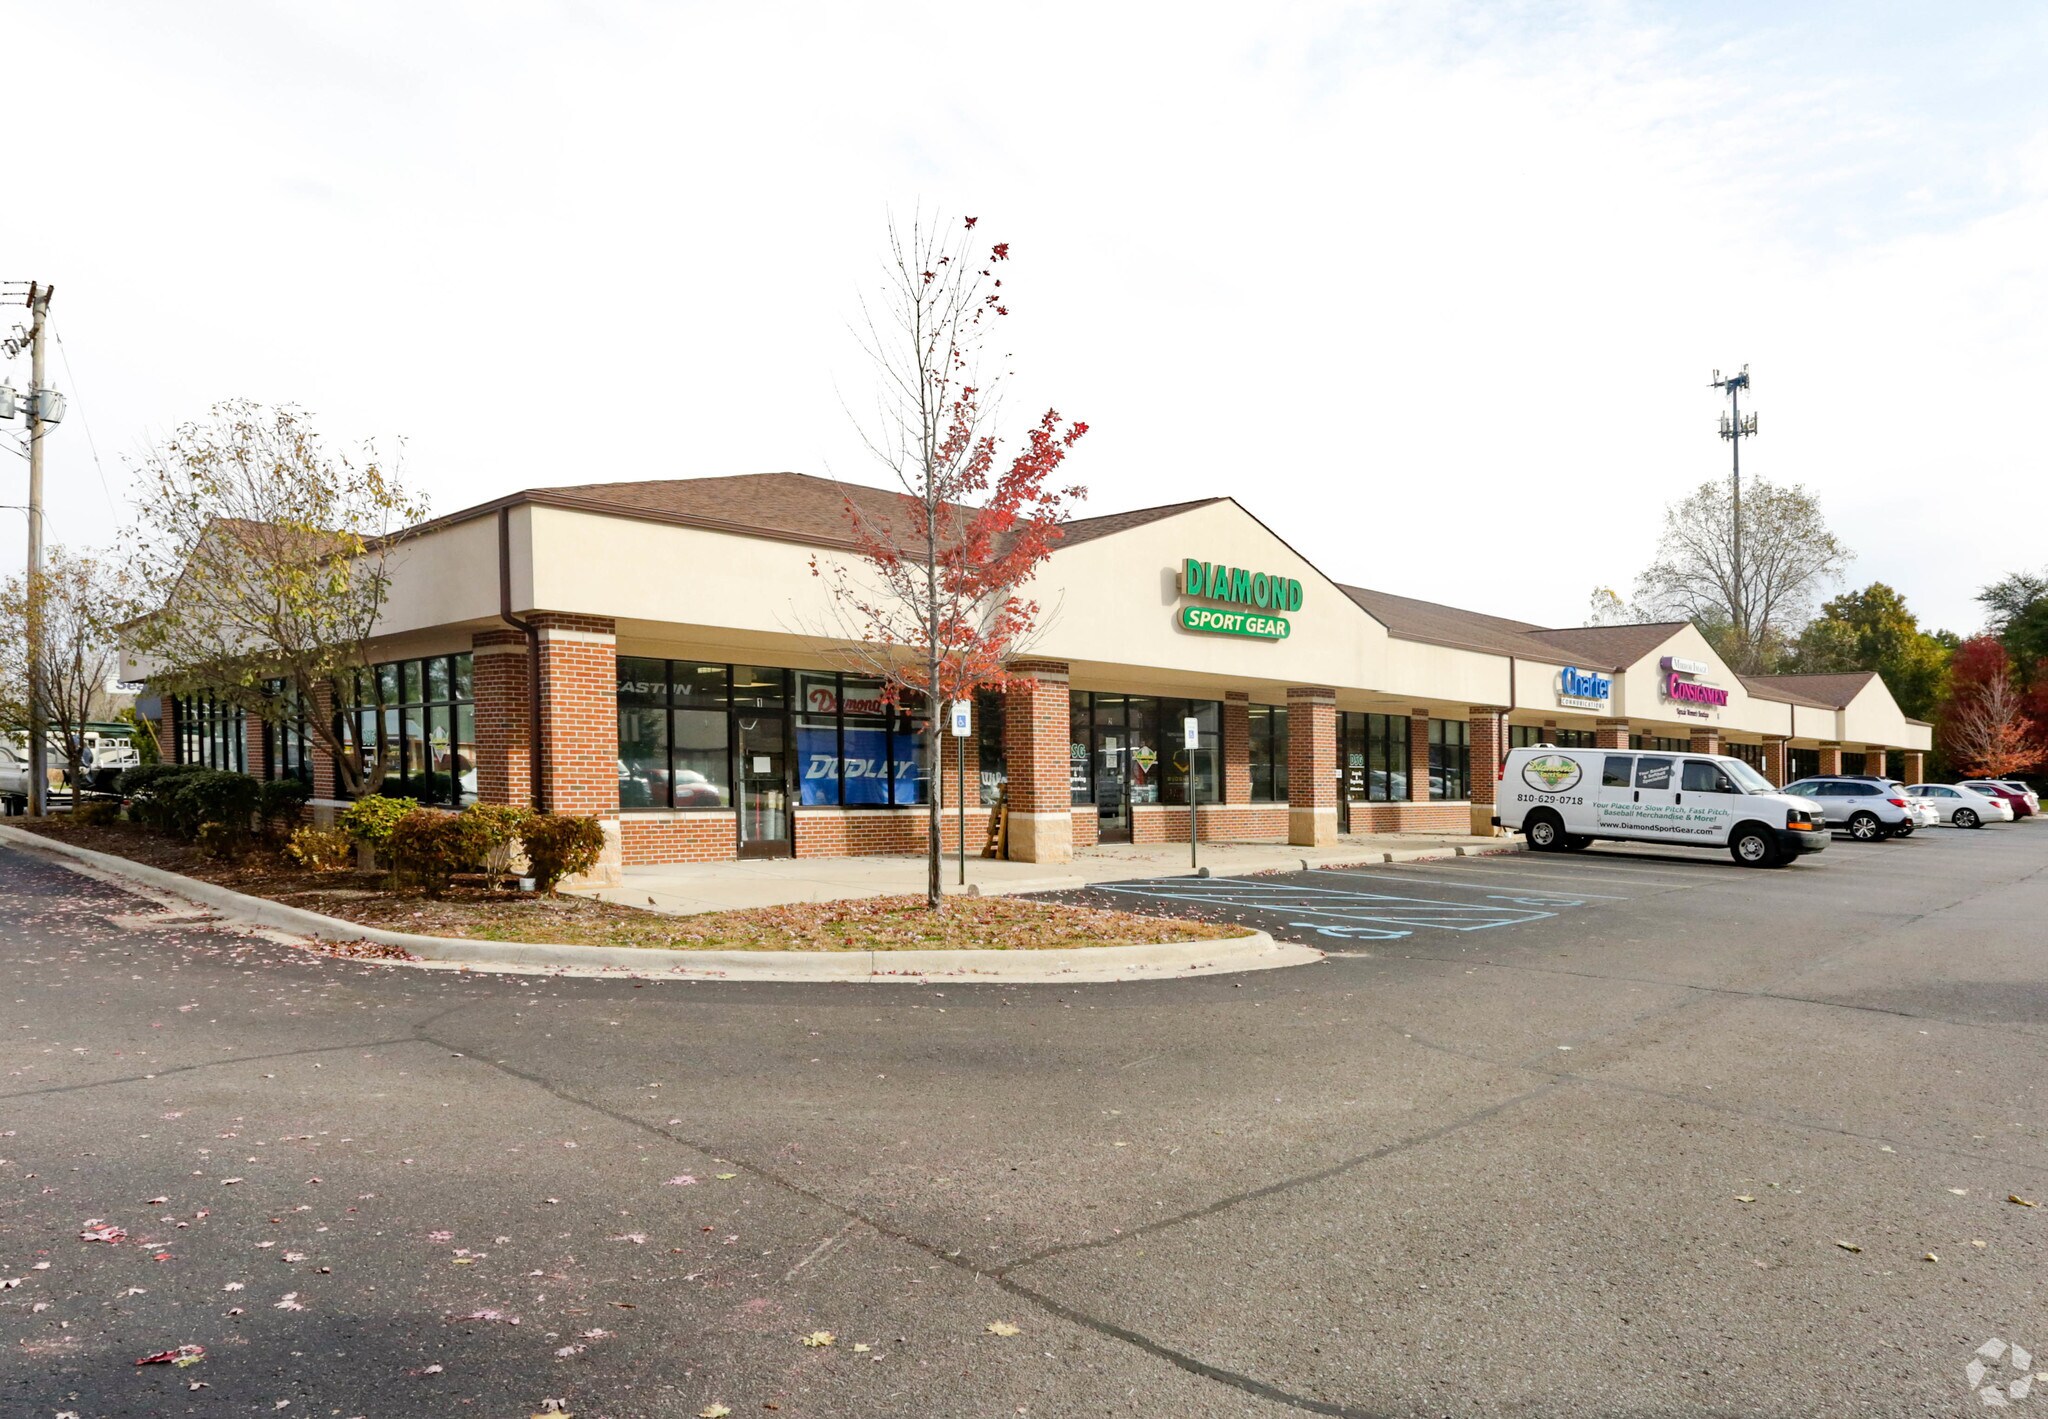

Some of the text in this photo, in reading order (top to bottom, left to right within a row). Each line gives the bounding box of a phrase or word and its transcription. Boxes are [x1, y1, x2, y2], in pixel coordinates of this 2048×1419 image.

[1184, 558, 1303, 612] DIAMOND
[1188, 610, 1286, 636] SPORT GEAR
[1562, 666, 1612, 699] Charter
[1669, 673, 1728, 706] CONSIGNMENT
[809, 689, 884, 715] Dmond
[1562, 699, 1605, 709] COMMUNICATIONS
[1070, 743, 1086, 758] SG
[805, 754, 915, 779] DUDLEY
[1350, 753, 1363, 766] DSG
[1517, 793, 1583, 805] 810-629-0718
[1604, 809, 1634, 817] Baseball
[1636, 811, 1684, 821] Merchandise
[1693, 815, 1717, 823] More!
[1611, 802, 1630, 810] Place
[1665, 806, 1686, 814] Pitch,
[1708, 808, 1730, 816] Pitch,
[1599, 822, 1713, 835] www.DiamondSportGear.com
